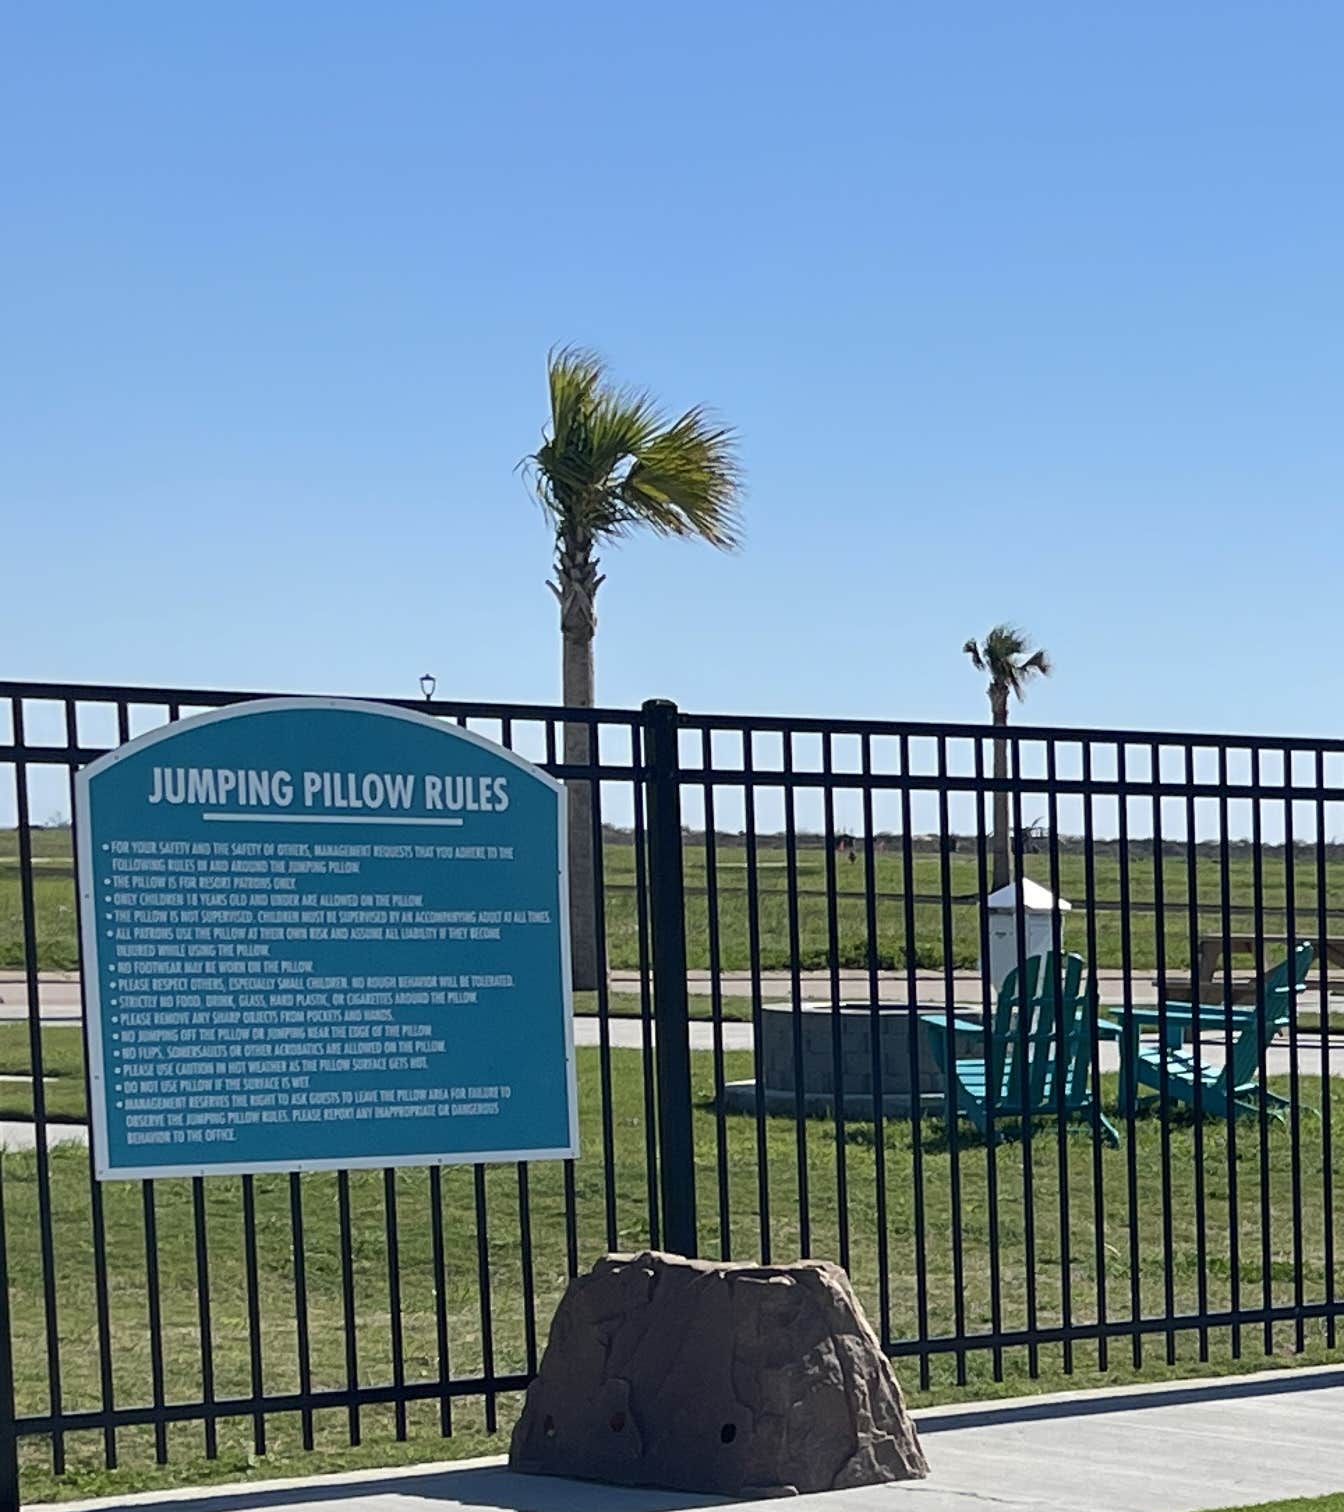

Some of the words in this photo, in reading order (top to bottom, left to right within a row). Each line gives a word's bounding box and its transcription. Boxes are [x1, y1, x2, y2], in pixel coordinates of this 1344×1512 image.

[148, 767, 294, 807] JUMPING
[303, 771, 415, 809] PILLOW
[424, 775, 509, 811] RULES
[191, 842, 211, 854] AND
[212, 842, 229, 854] THE
[209, 859, 228, 871] AND
[112, 875, 129, 888] THE
[131, 875, 165, 888] PILLOW
[249, 893, 268, 905] AND
[114, 909, 131, 922] THE
[133, 909, 167, 922] PILLOW
[194, 927, 211, 939] THE
[213, 927, 245, 939] PILLOW
[330, 927, 348, 939] AND
[217, 944, 234, 956] THE
[263, 960, 279, 973] THE
[118, 978, 150, 990] PLEASE
[430, 991, 445, 1003] THE
[120, 1012, 151, 1024] PLEASE
[344, 1009, 361, 1021] AND
[198, 1028, 215, 1040] THE
[217, 1027, 250, 1040] PILLOW
[331, 1025, 346, 1037] THE
[384, 1024, 399, 1036] THE
[123, 1063, 154, 1075] PLEASE
[301, 1059, 317, 1071] THE
[319, 1058, 350, 1071] PILLOW
[179, 1078, 212, 1091] PILLOW
[224, 1078, 241, 1090] THE
[231, 1094, 247, 1106] THE
[396, 1088, 426, 1101] PILLOW
[227, 1110, 259, 1123] PILLOW
[291, 1108, 321, 1121] PLEASE
[186, 1129, 202, 1142] THE
